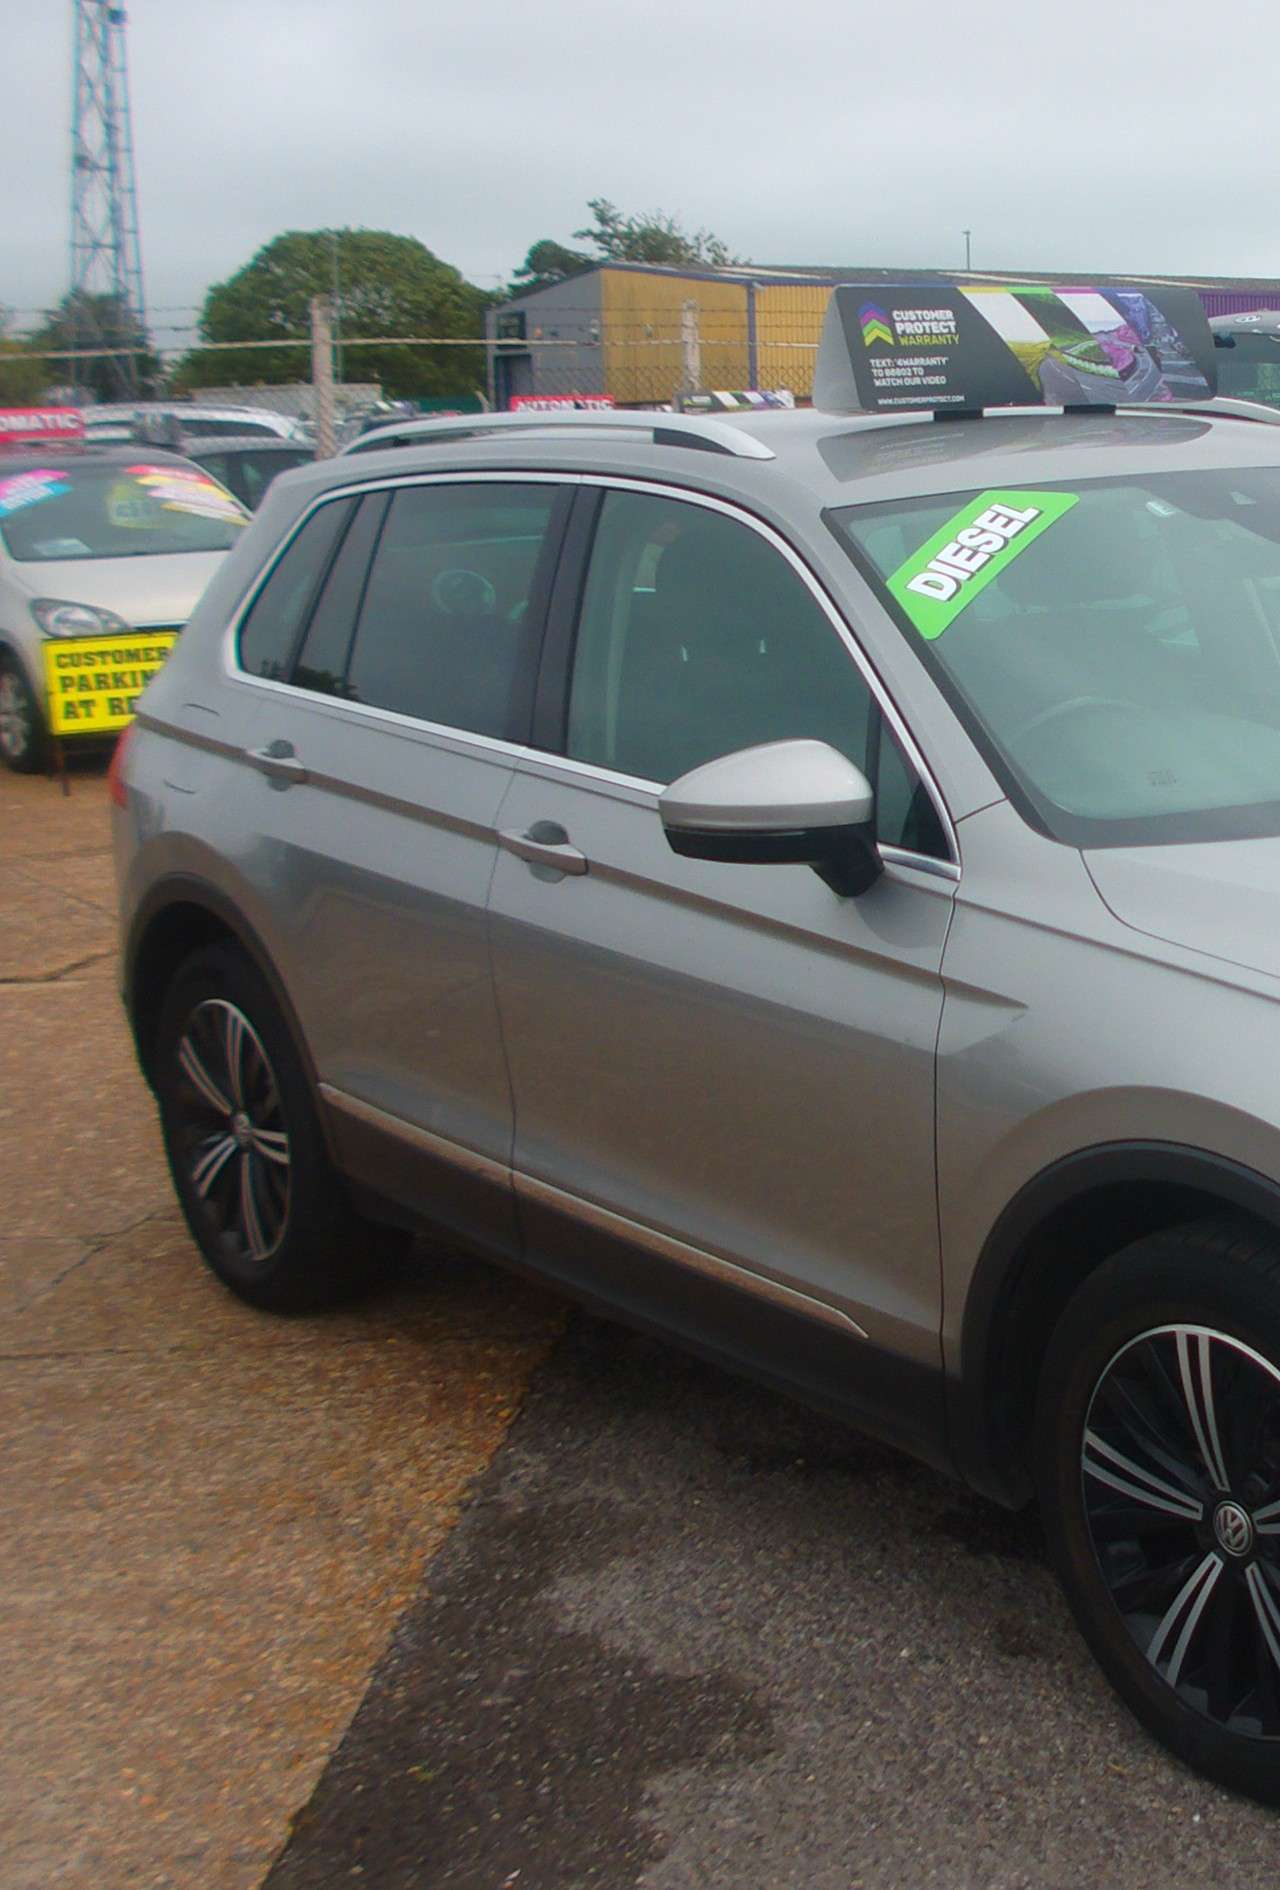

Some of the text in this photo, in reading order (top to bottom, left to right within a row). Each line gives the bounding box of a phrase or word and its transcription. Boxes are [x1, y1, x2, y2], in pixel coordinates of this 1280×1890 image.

[892, 309, 954, 321] CUSTOMER
[895, 321, 957, 335] PROTECT
[899, 334, 960, 346] WARRANTY
[906, 503, 1043, 602] DIESEL
[56, 646, 169, 669] CUSTOMER
[63, 698, 96, 720] AT
